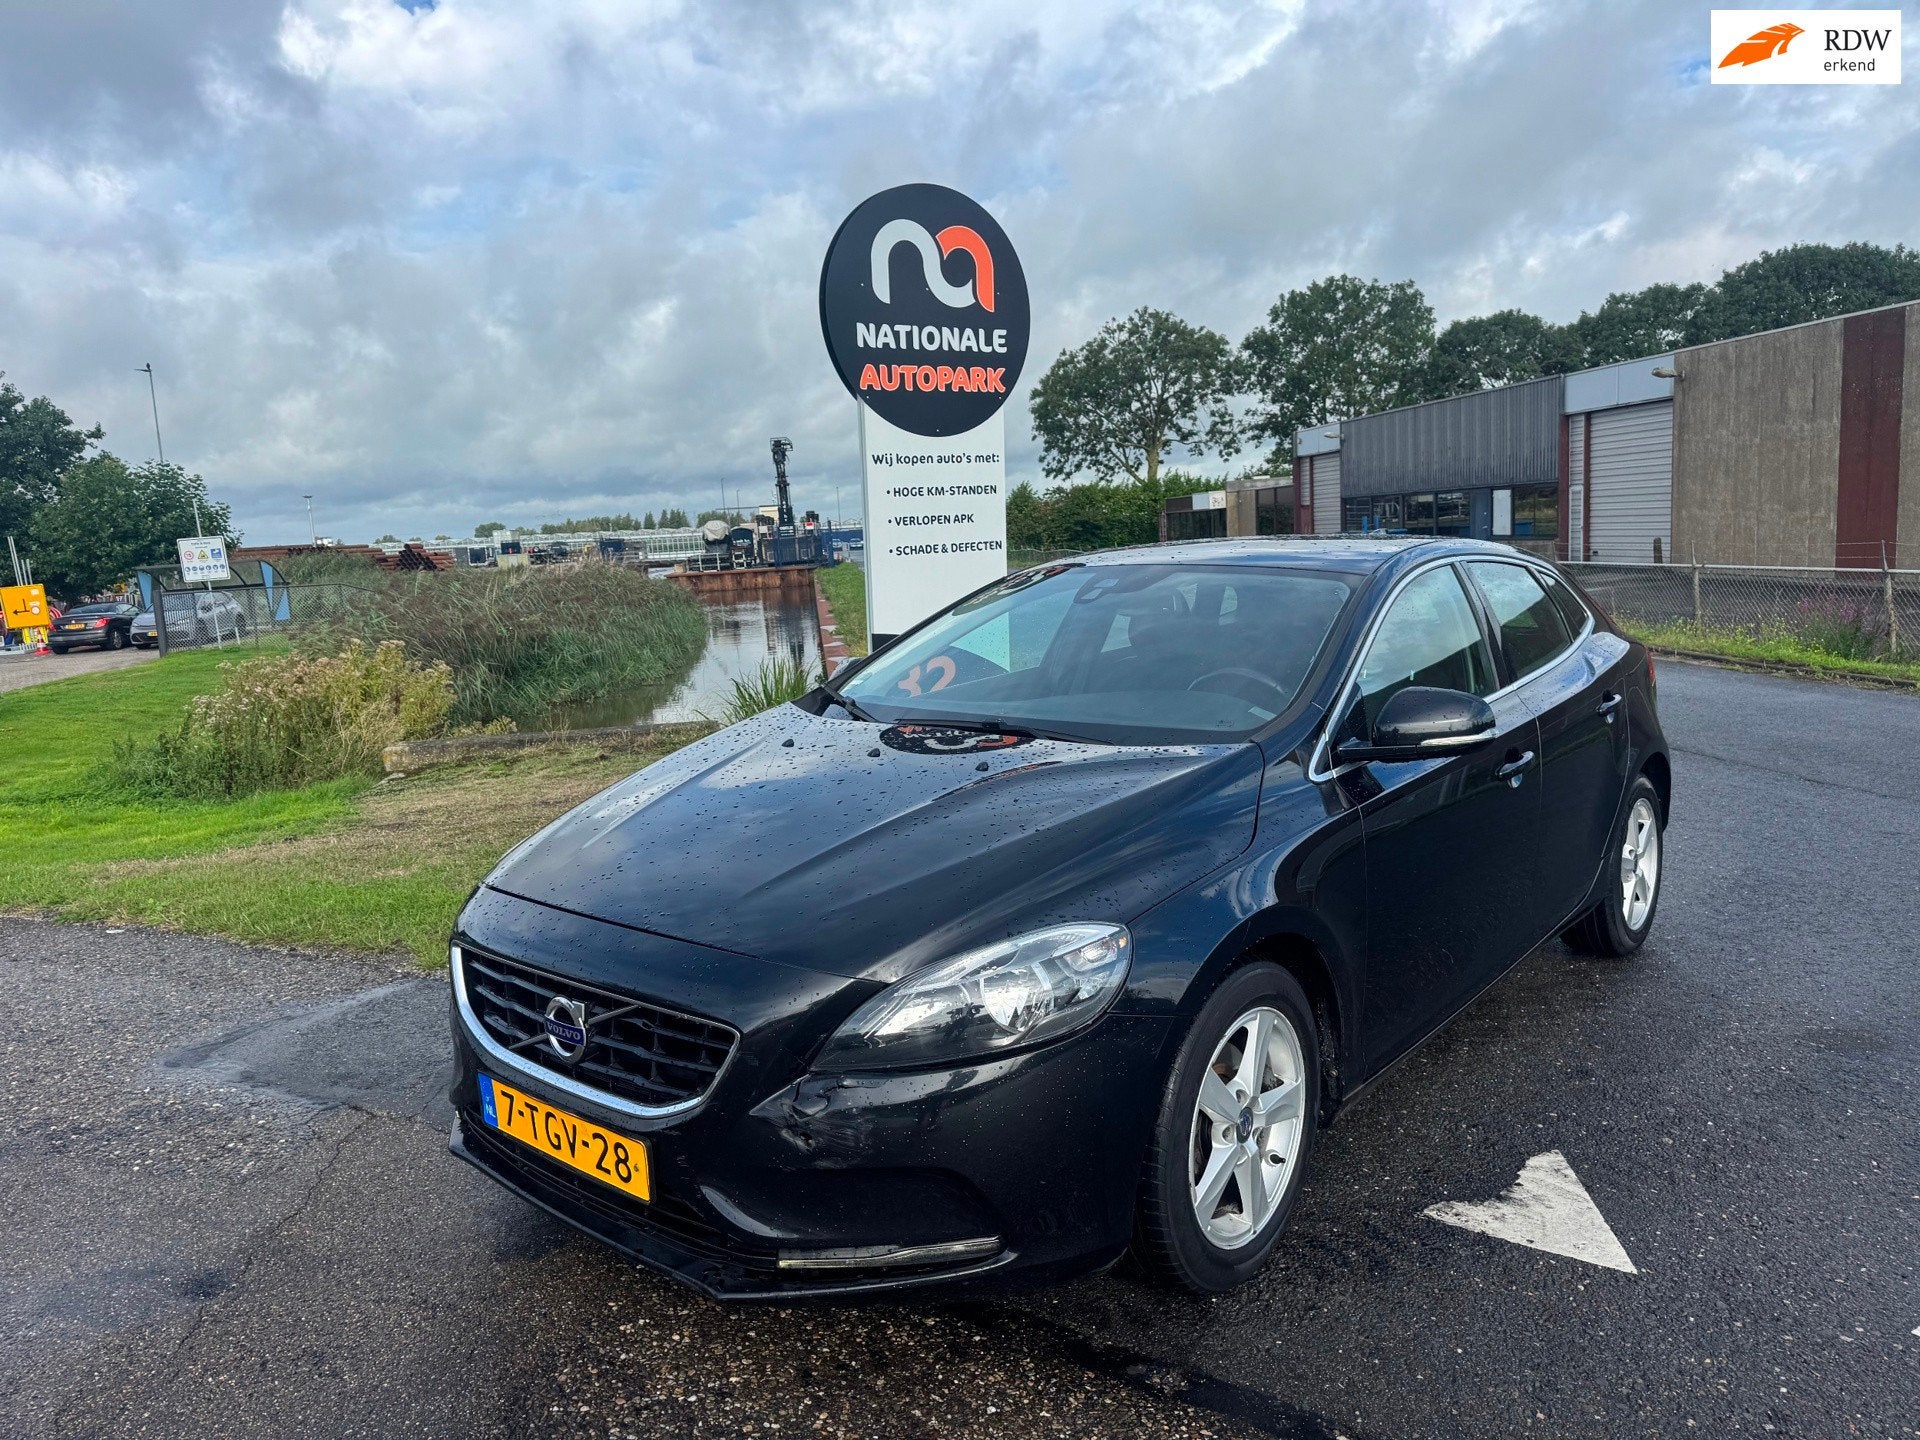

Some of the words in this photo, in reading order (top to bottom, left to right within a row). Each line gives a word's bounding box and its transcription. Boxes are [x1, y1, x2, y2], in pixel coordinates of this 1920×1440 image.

[856, 321, 1008, 353] NATIONALE
[859, 363, 1006, 393] AUTOPARK
[871, 453, 893, 467] Wij
[896, 453, 934, 467] kopen
[936, 452, 972, 464] auto's
[974, 452, 1000, 464] met:
[893, 486, 924, 498] HOGE
[926, 484, 997, 497] KM-STANDEN
[894, 514, 951, 527] VERLOPEN
[953, 513, 975, 524] APK
[895, 544, 939, 557] SCHADE
[940, 543, 949, 554] &
[950, 540, 1003, 553] DEFECTEN
[545, 1020, 582, 1041] VOLVO
[485, 1103, 497, 1118] NL
[500, 1089, 633, 1184] 7-TGV-28
